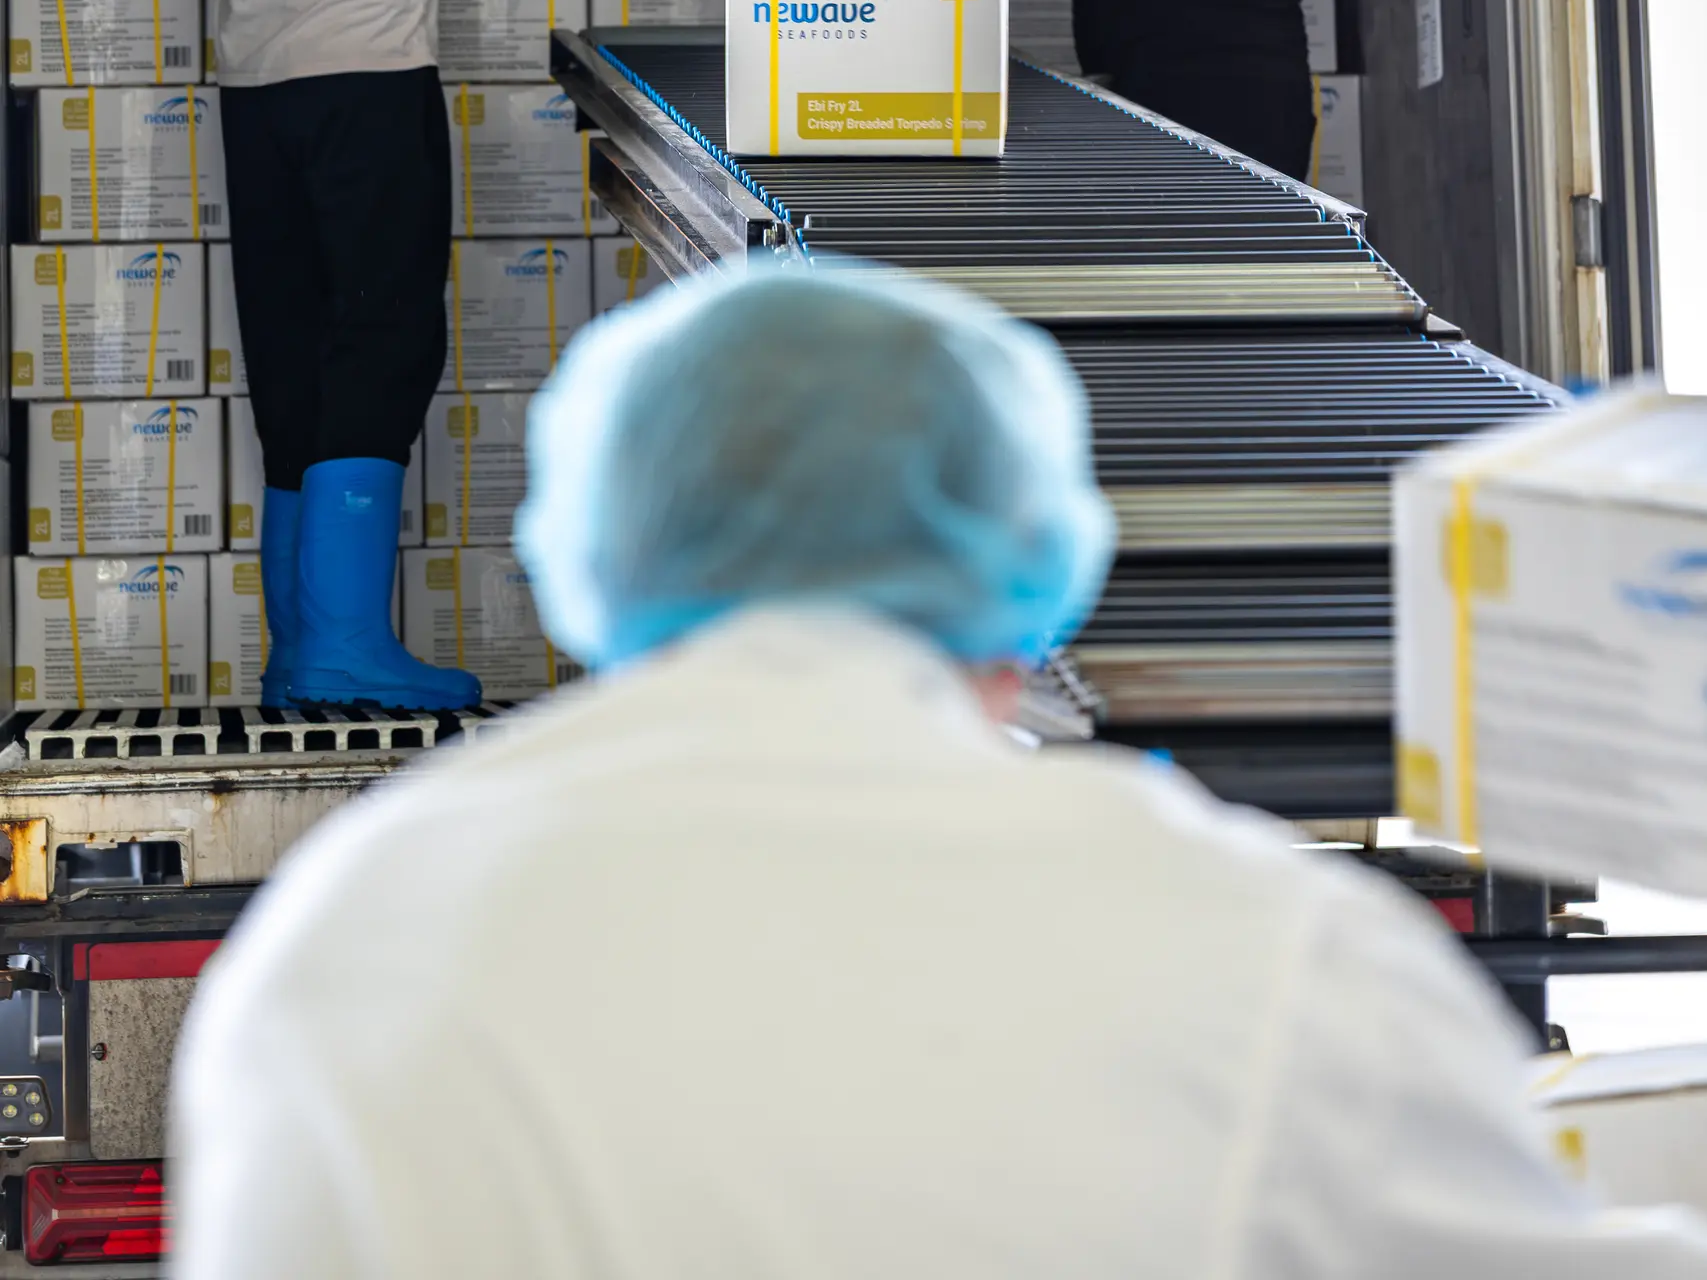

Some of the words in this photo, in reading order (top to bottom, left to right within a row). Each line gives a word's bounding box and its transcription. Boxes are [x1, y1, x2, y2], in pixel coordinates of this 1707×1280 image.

[754, 1, 876, 23] newave
[778, 29, 868, 40] SEAFOODS
[17, 51, 30, 66] 2L
[808, 100, 826, 112] Ebi
[828, 100, 846, 114] Fry
[848, 100, 863, 112] 2L
[808, 117, 843, 132] Crispy
[846, 117, 894, 129] Breaded
[896, 117, 943, 132] Torpedo
[945, 117, 987, 131] Srimp
[47, 207, 60, 223] 2L
[18, 363, 31, 380] 2L
[217, 360, 230, 376] 2L
[36, 519, 49, 536] 2L
[238, 516, 252, 532] 2L
[20, 677, 33, 693] 2L
[216, 674, 230, 690] 2L
